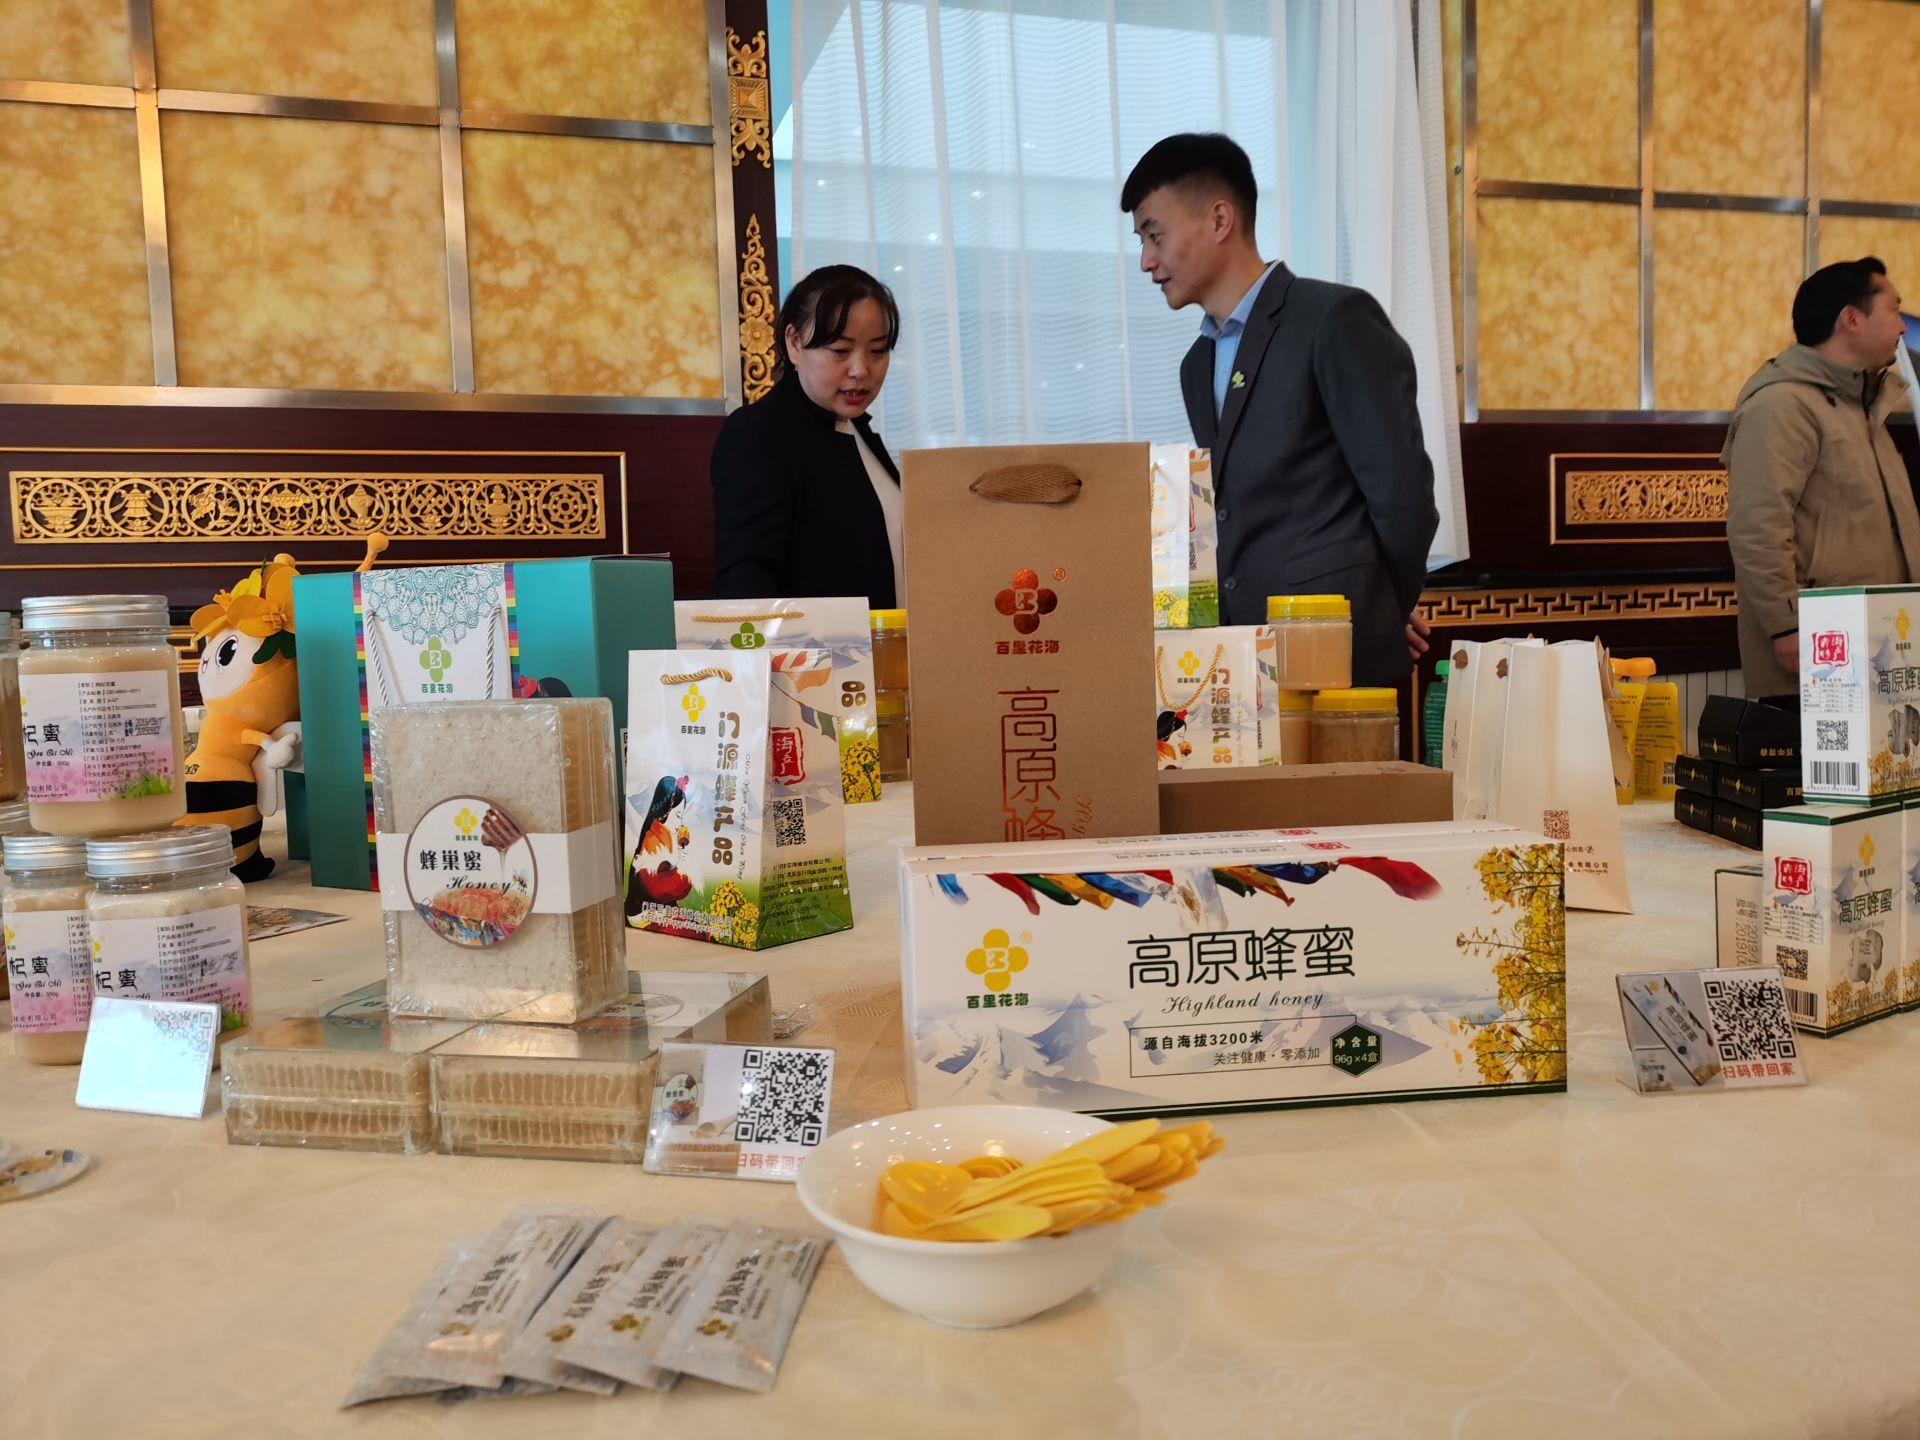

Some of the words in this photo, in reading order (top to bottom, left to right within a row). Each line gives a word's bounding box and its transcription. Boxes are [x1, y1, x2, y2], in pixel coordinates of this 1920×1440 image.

[995, 639, 1060, 655] 百里花海
[1878, 664, 1920, 695] 高原蜂
[420, 849, 482, 871] 蜂巢蜜
[446, 875, 512, 895] Honey
[1839, 888, 1892, 926] 高原蜂蜜
[9, 956, 50, 978] 杞蜜
[1127, 923, 1356, 989] 高原蜂蜜
[95, 968, 138, 992] 杞蜜
[965, 993, 1029, 1010] 百里花海
[1161, 993, 1259, 1015] Highland
[1269, 989, 1324, 1010] honey
[1144, 1030, 1264, 1051] 源自海拔3200米
[1334, 1035, 1378, 1049] 净含量
[1722, 1062, 1794, 1079] 扫码带回家
